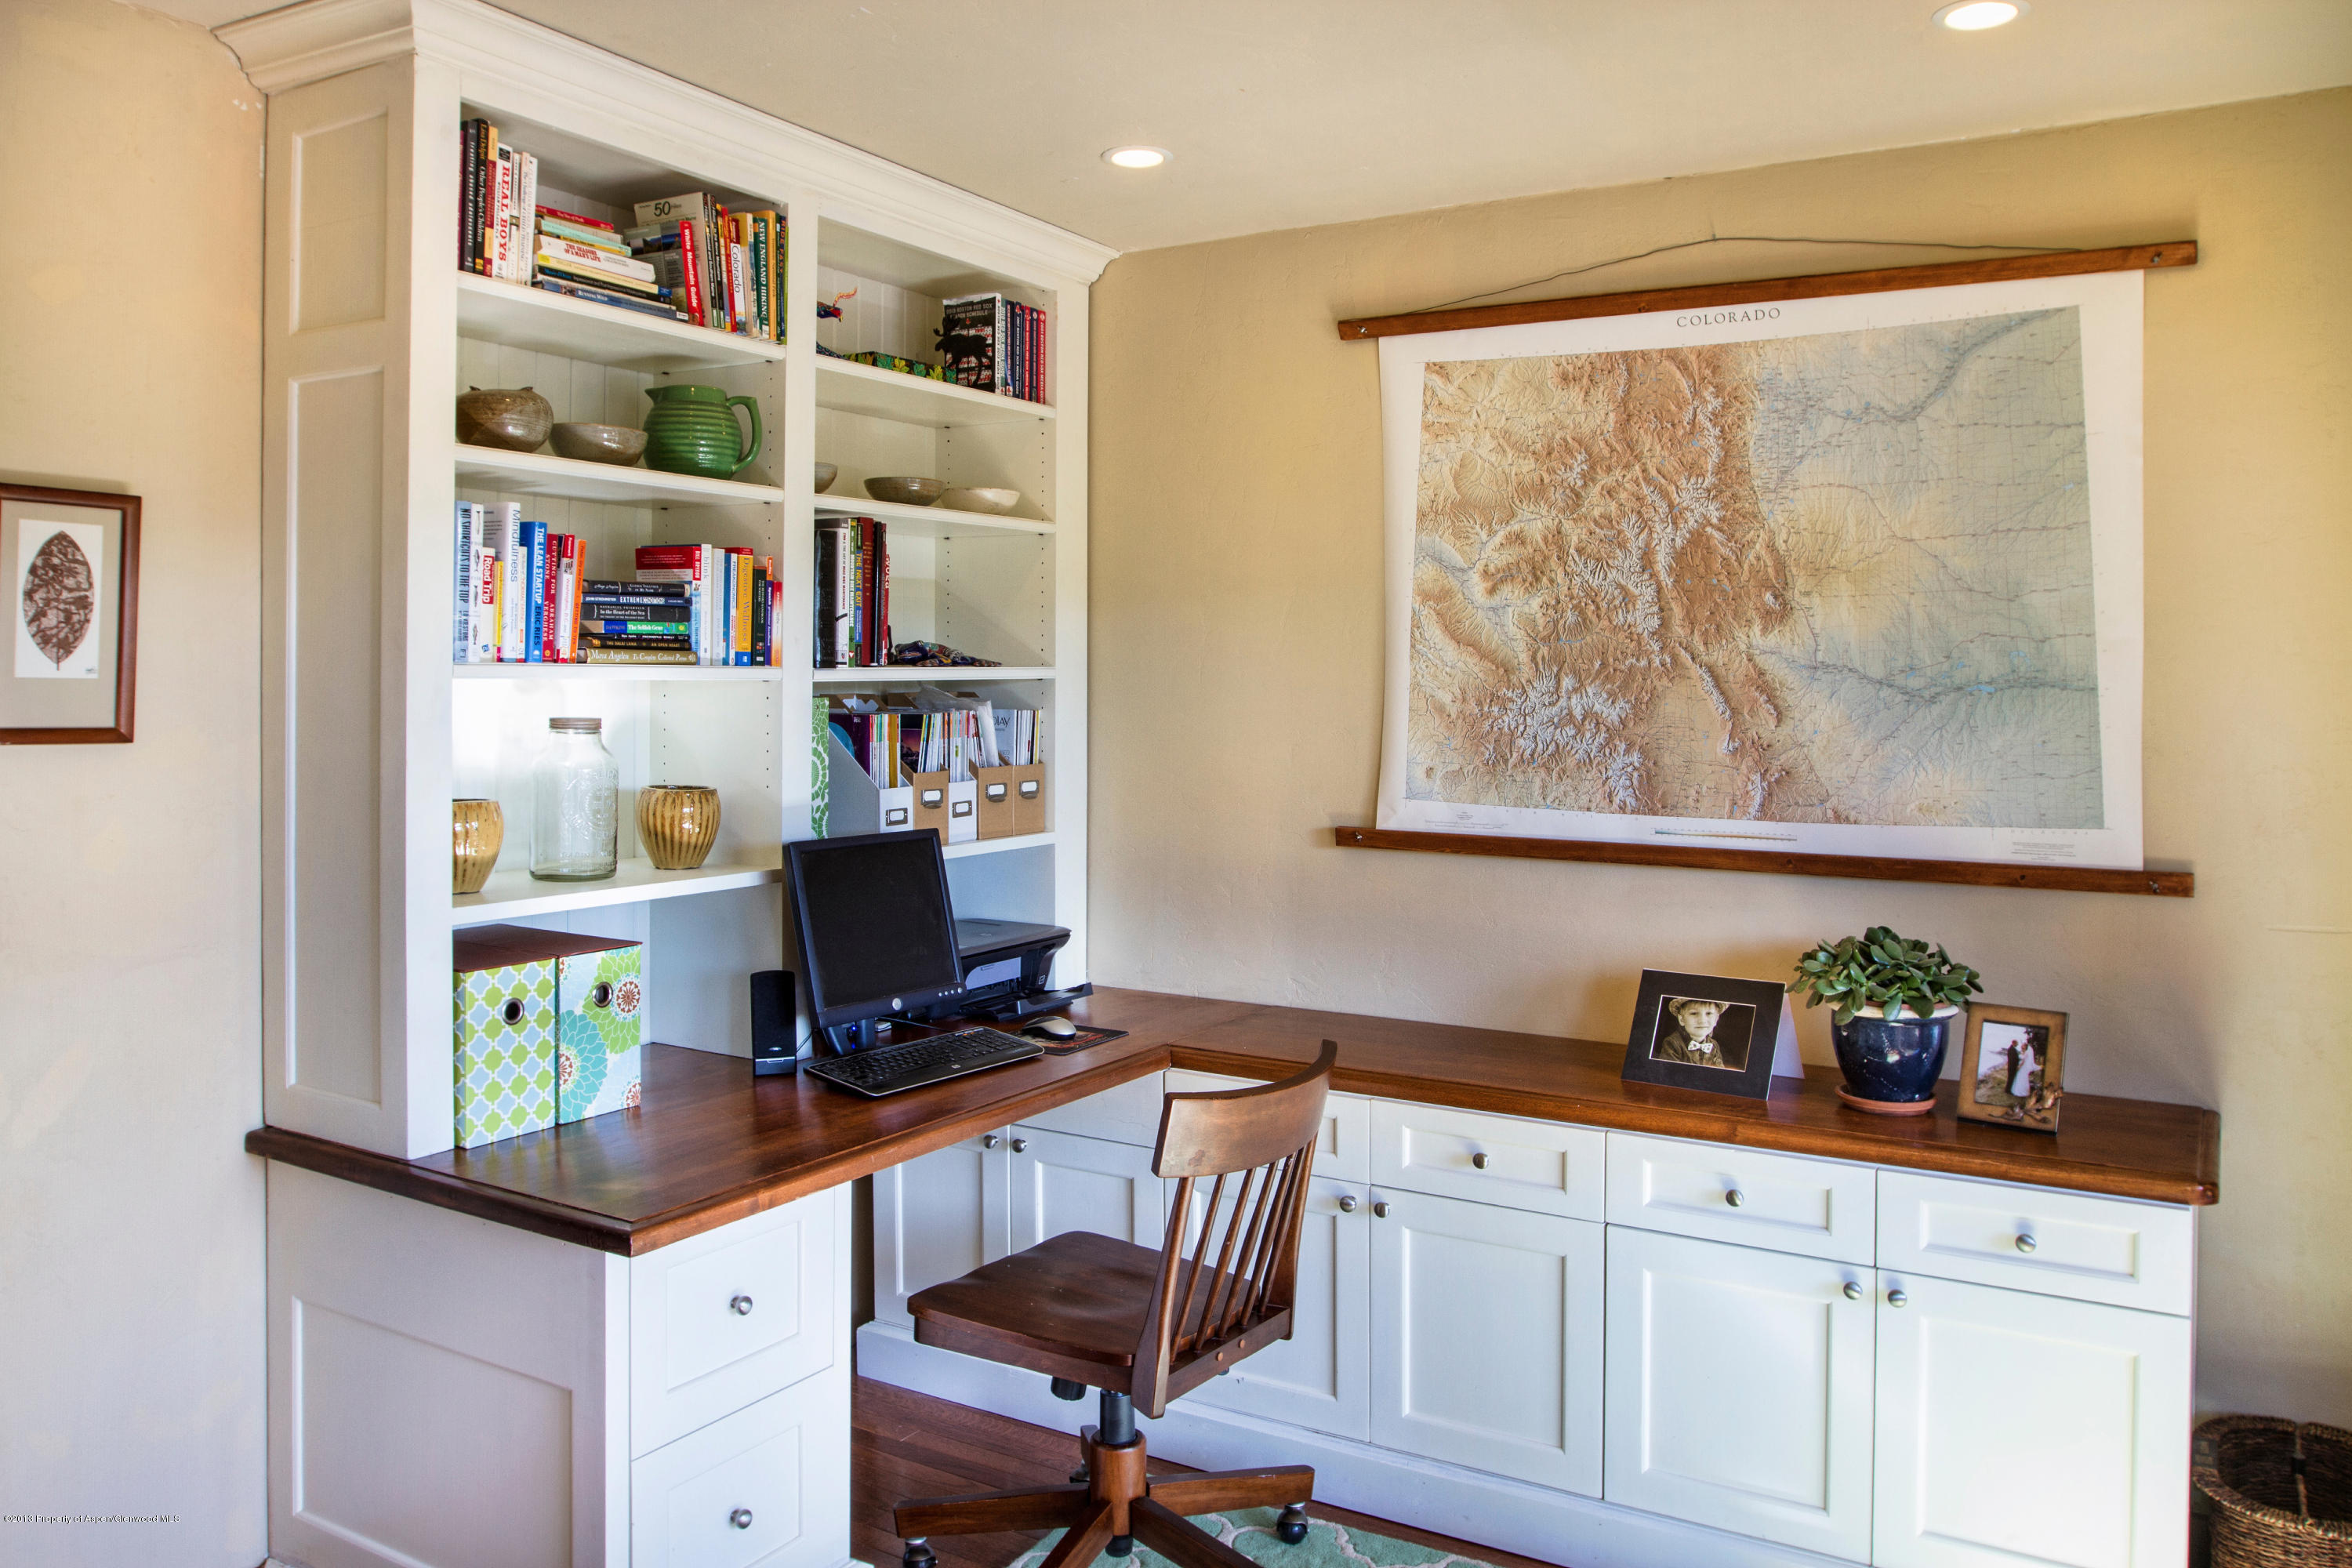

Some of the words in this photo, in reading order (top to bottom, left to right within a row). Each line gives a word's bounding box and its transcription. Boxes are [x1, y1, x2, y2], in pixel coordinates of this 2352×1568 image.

[477, 187, 486, 211] People's
[500, 165, 510, 212] REAL
[654, 201, 671, 217] 50
[498, 217, 508, 262] BOYS
[687, 252, 697, 285] Mountain
[731, 245, 743, 294] Colorado
[690, 287, 699, 307] Guide
[1676, 307, 1781, 328] COLORADO
[460, 508, 471, 518] NO
[459, 521, 471, 563] SHORTCUTS
[510, 510, 521, 583] Mindfulness
[459, 564, 470, 573] TO
[483, 557, 492, 582] Road
[742, 558, 750, 598] Digestive
[459, 575, 470, 588] THE
[535, 568, 543, 604] STARTUP
[459, 590, 470, 604] TOP
[481, 585, 492, 604] Trip
[591, 650, 608, 662] Maya
[608, 651, 630, 662] Angelou
